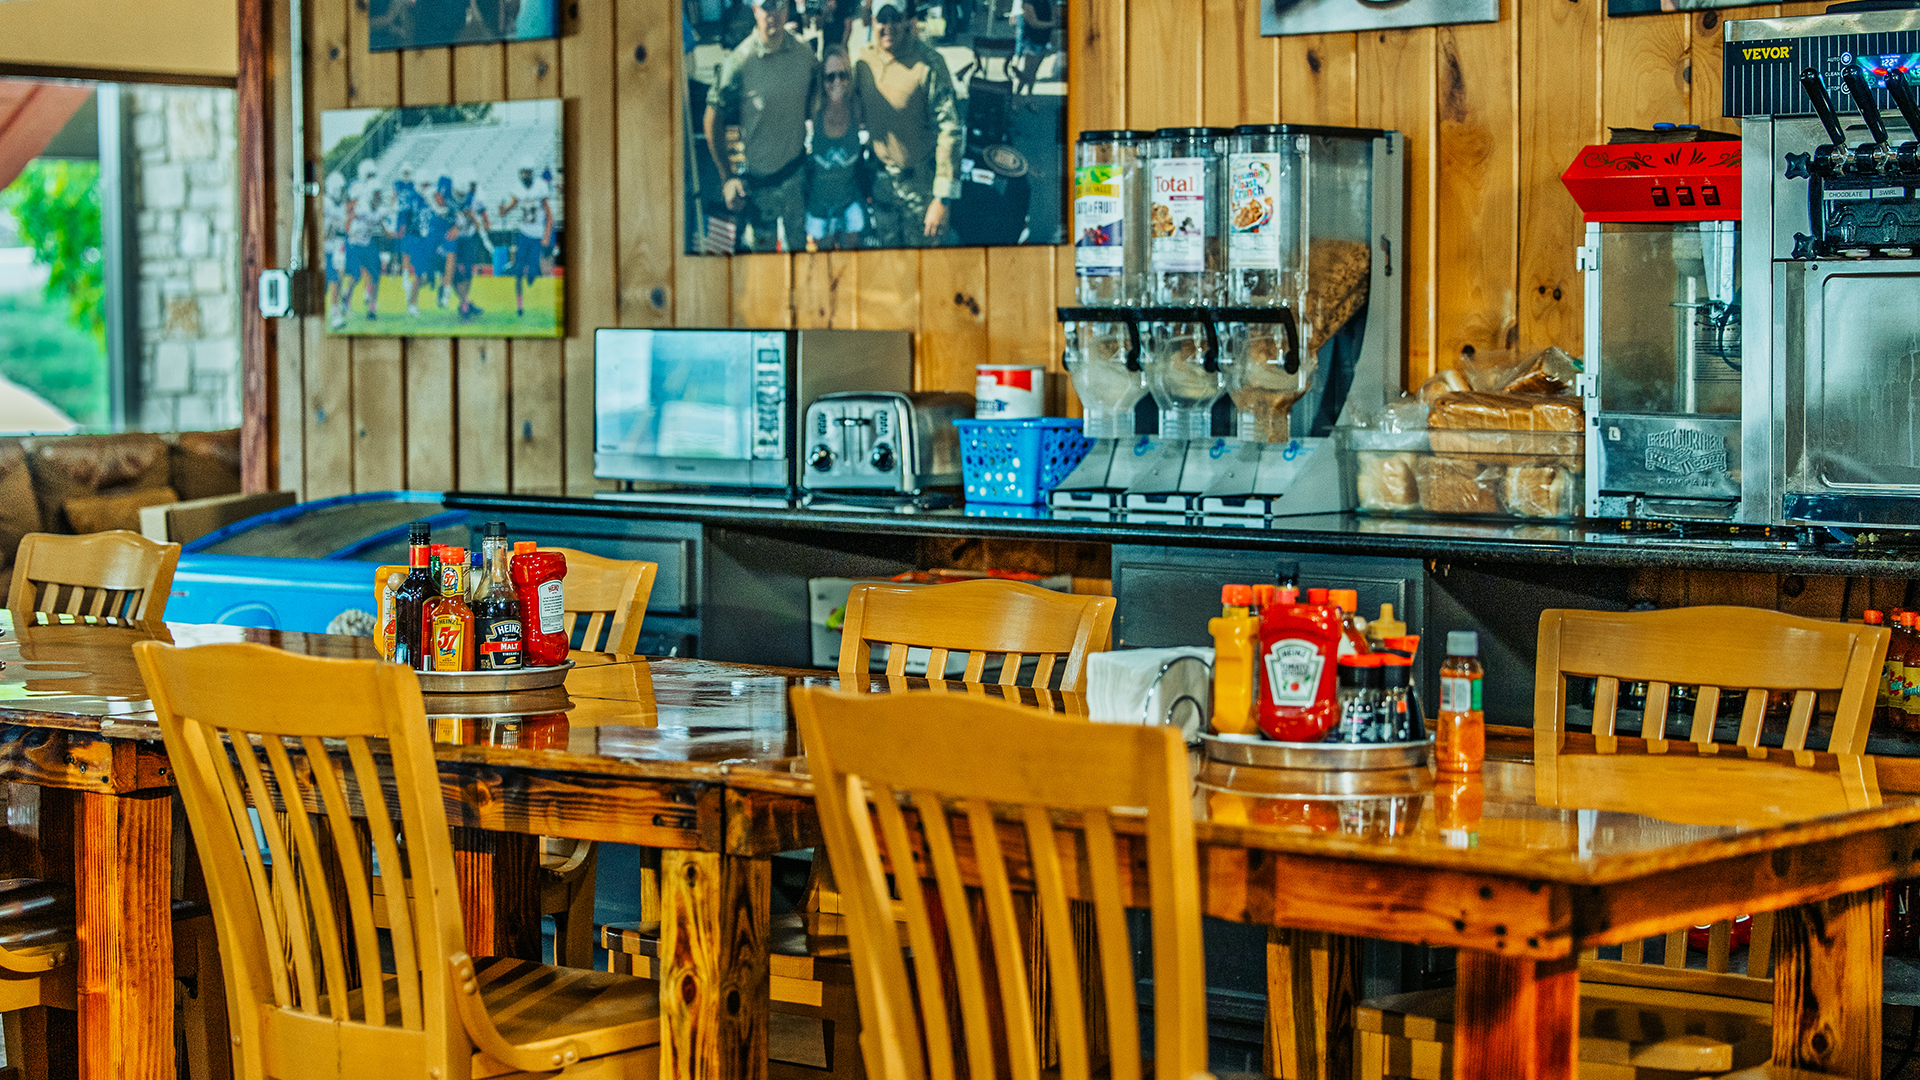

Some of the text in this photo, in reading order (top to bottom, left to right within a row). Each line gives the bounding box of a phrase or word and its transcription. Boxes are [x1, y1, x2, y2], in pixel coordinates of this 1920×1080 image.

[1742, 46, 1790, 60] VEVOR
[1155, 176, 1193, 192] Total
[1647, 428, 1725, 450] GREAT NORTHERN
[1657, 477, 1716, 487] COMPANY
[443, 573, 455, 586] 57
[497, 624, 520, 635] HEINZ
[437, 626, 460, 651] 57
